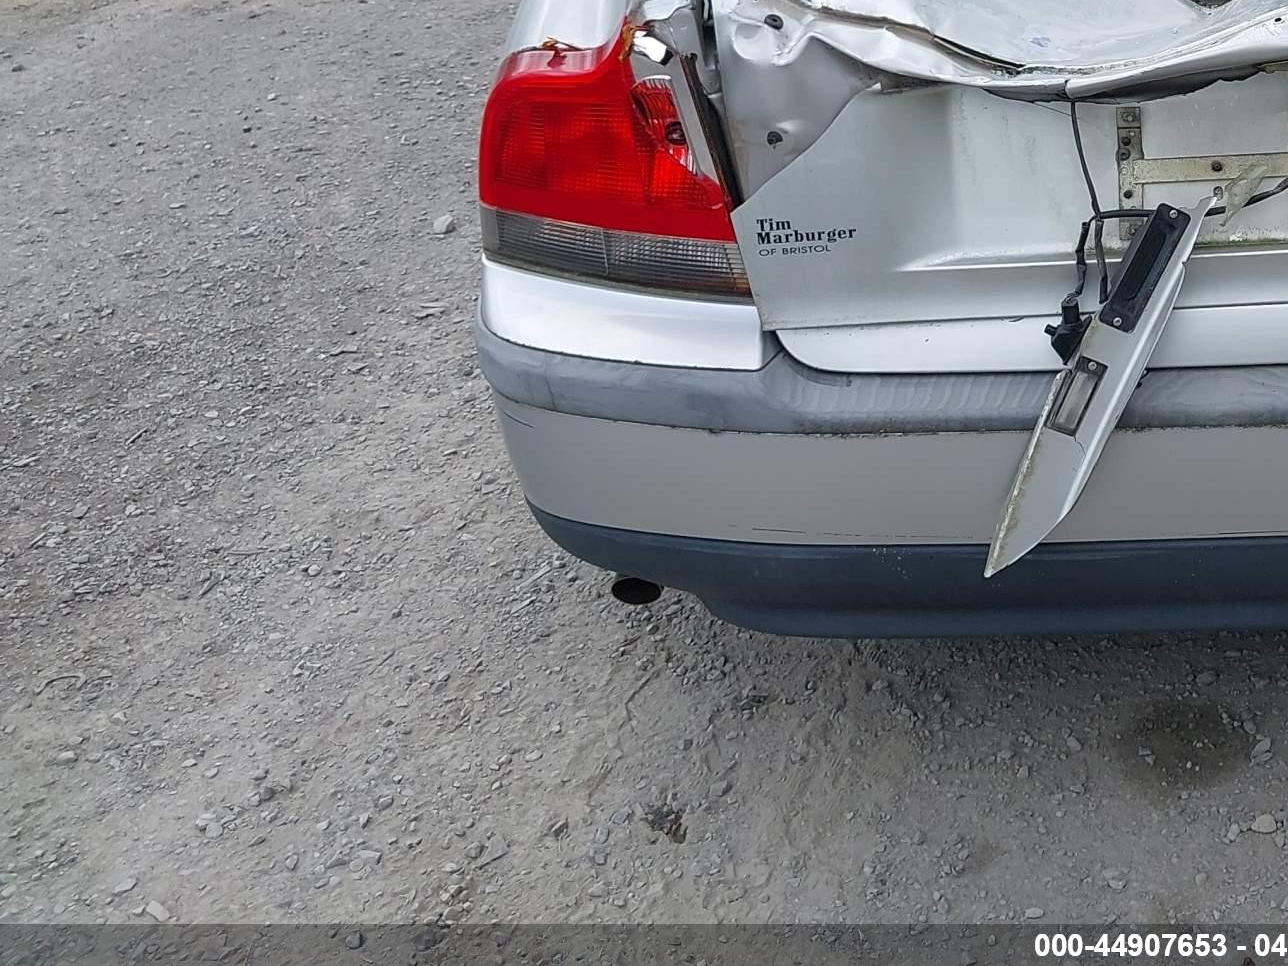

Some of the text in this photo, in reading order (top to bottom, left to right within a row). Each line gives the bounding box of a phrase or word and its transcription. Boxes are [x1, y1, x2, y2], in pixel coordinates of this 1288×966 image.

[756, 218, 792, 232] Tim
[756, 228, 857, 245] Marburger
[758, 244, 832, 257] OF BRISTOL
